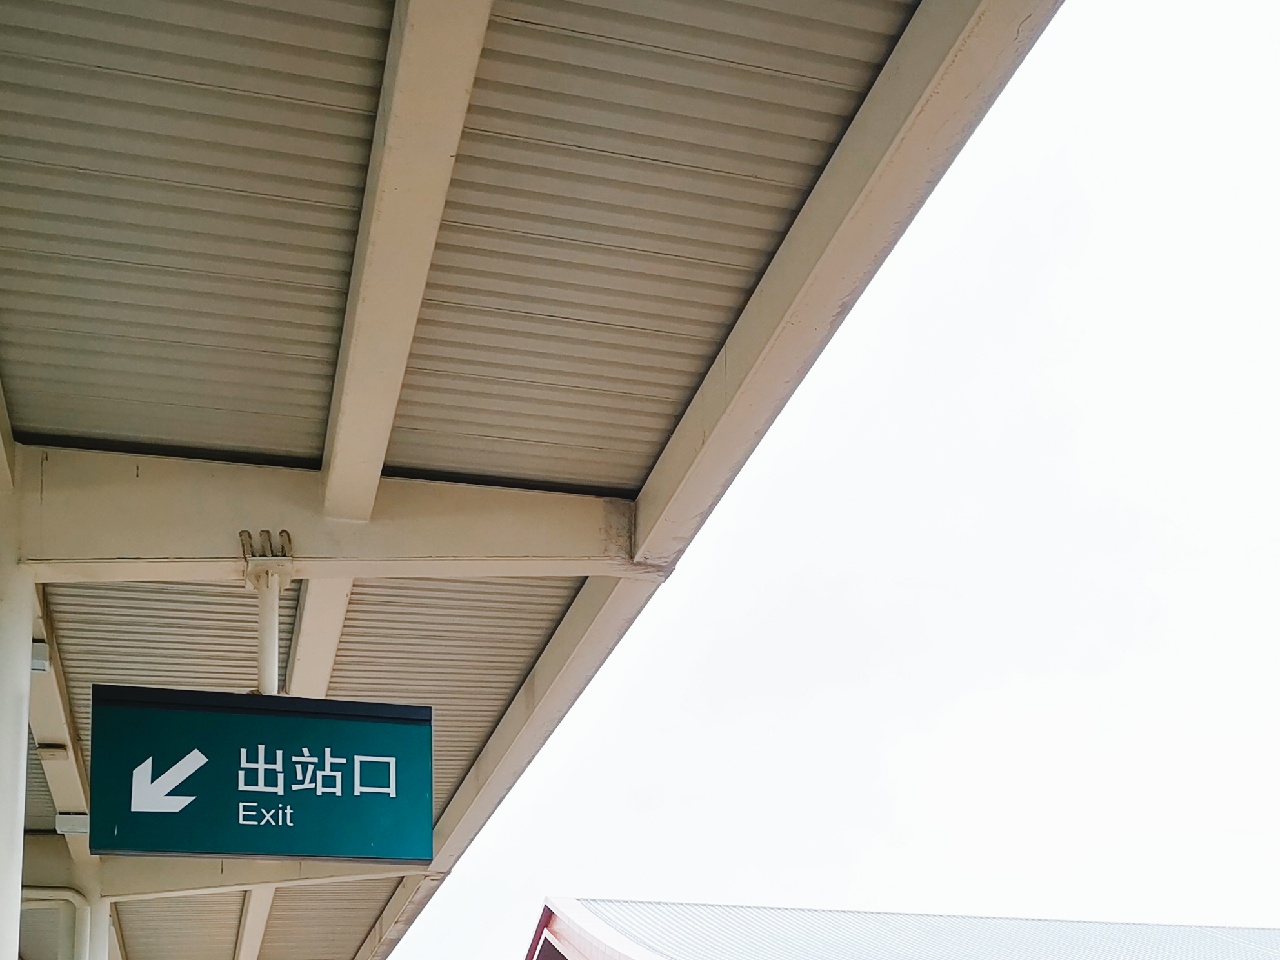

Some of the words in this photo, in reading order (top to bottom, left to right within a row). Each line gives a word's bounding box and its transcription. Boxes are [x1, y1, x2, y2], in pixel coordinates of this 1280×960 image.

[237, 744, 398, 798] 出站口
[238, 802, 294, 827] Exit
